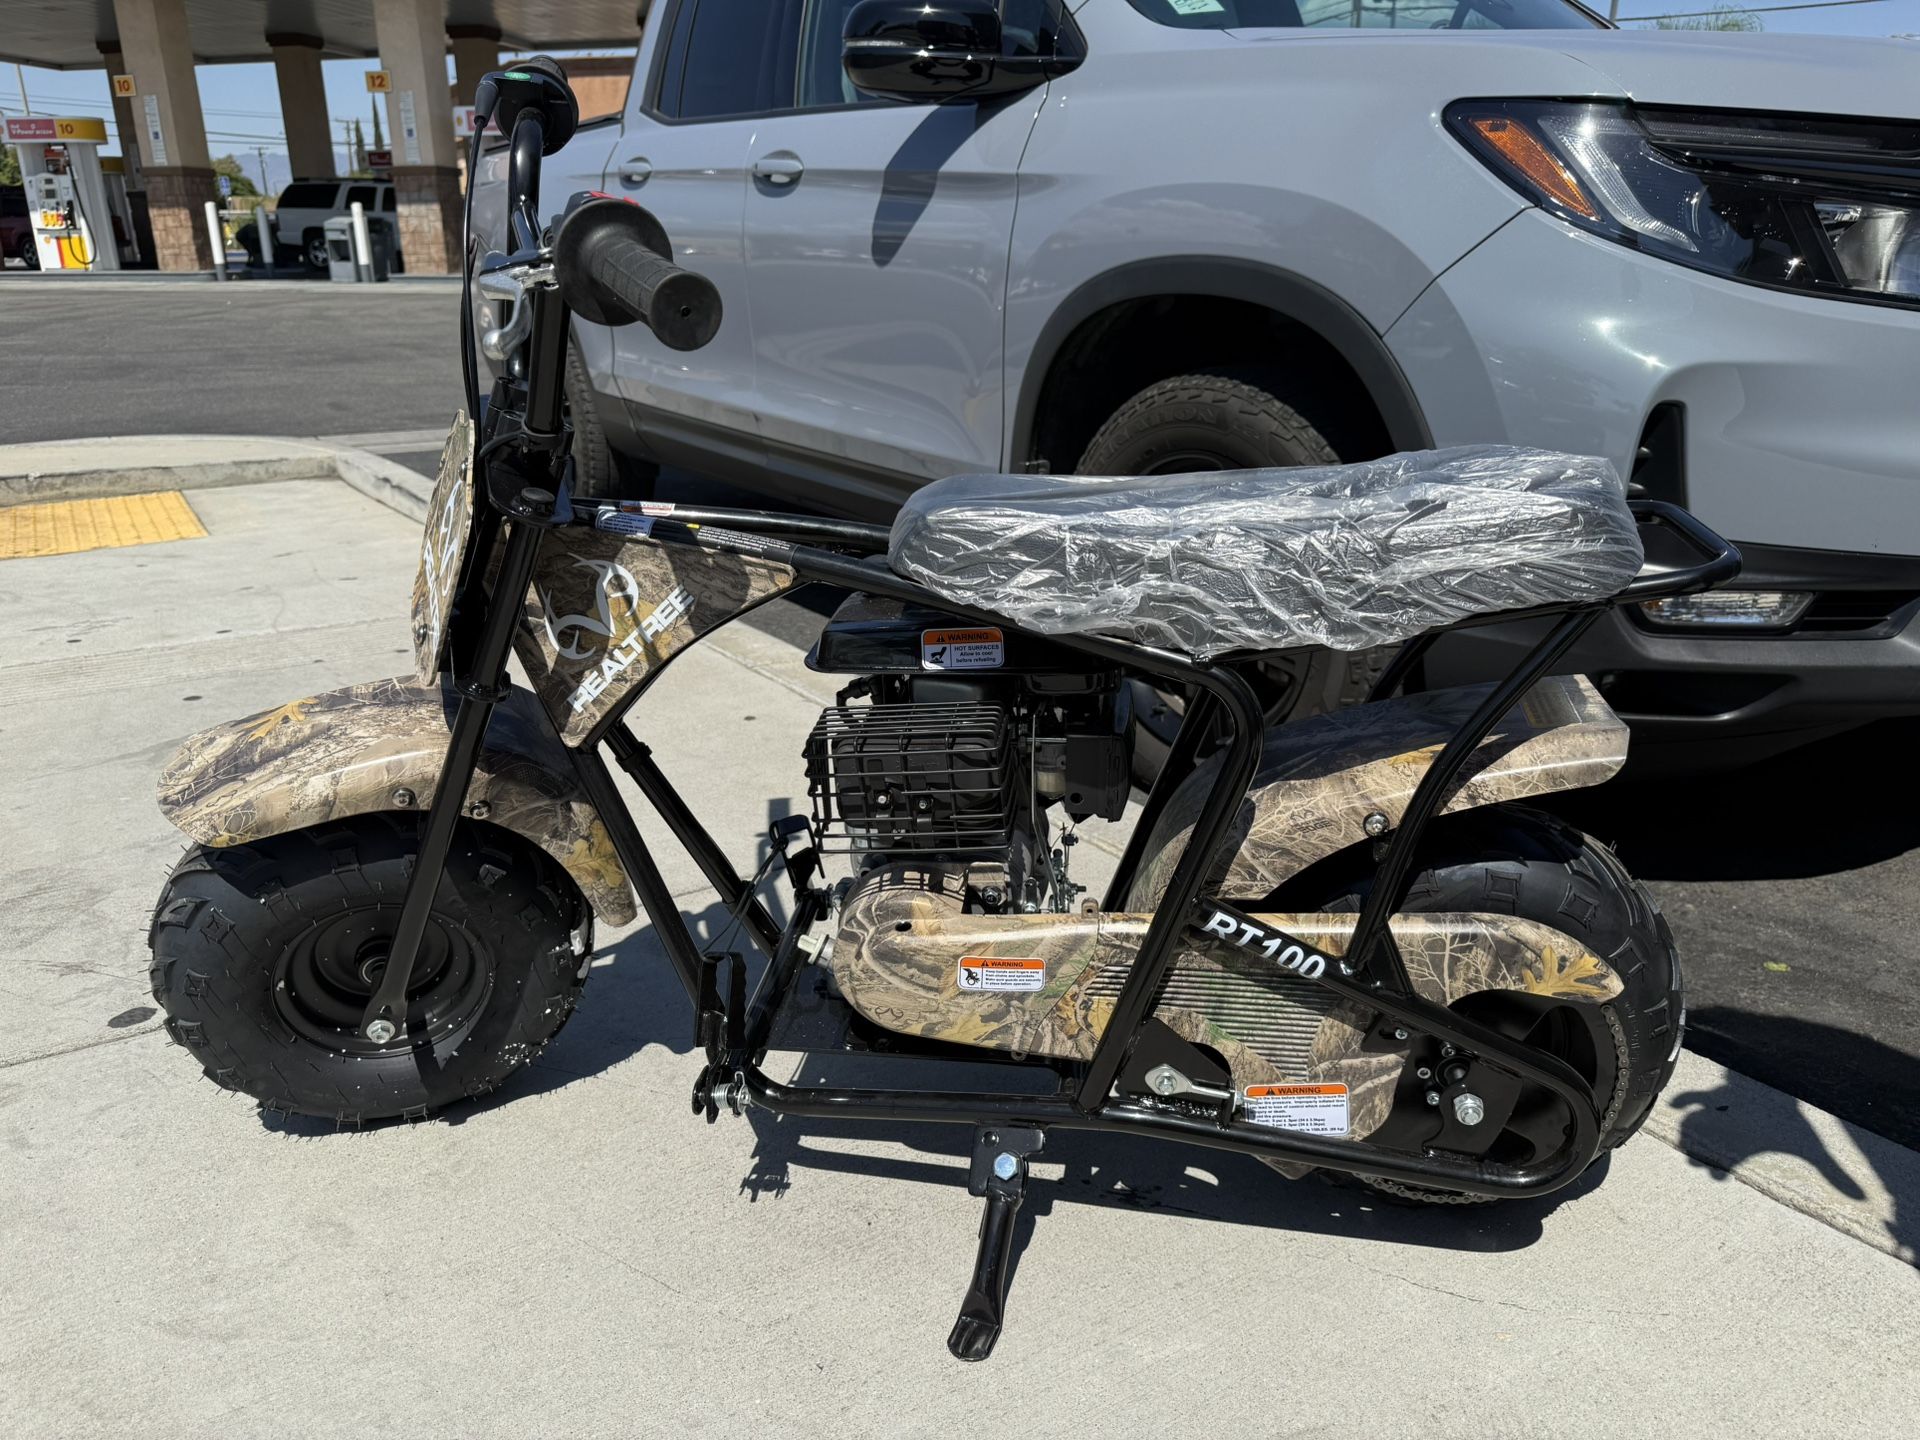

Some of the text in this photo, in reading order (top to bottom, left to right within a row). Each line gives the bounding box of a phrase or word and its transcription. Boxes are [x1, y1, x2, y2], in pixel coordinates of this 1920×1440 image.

[117, 80, 130, 92] 10
[369, 75, 386, 88] 12
[60, 123, 74, 135] 10
[566, 584, 695, 713] REALTREE
[1202, 911, 1326, 979] RT100
